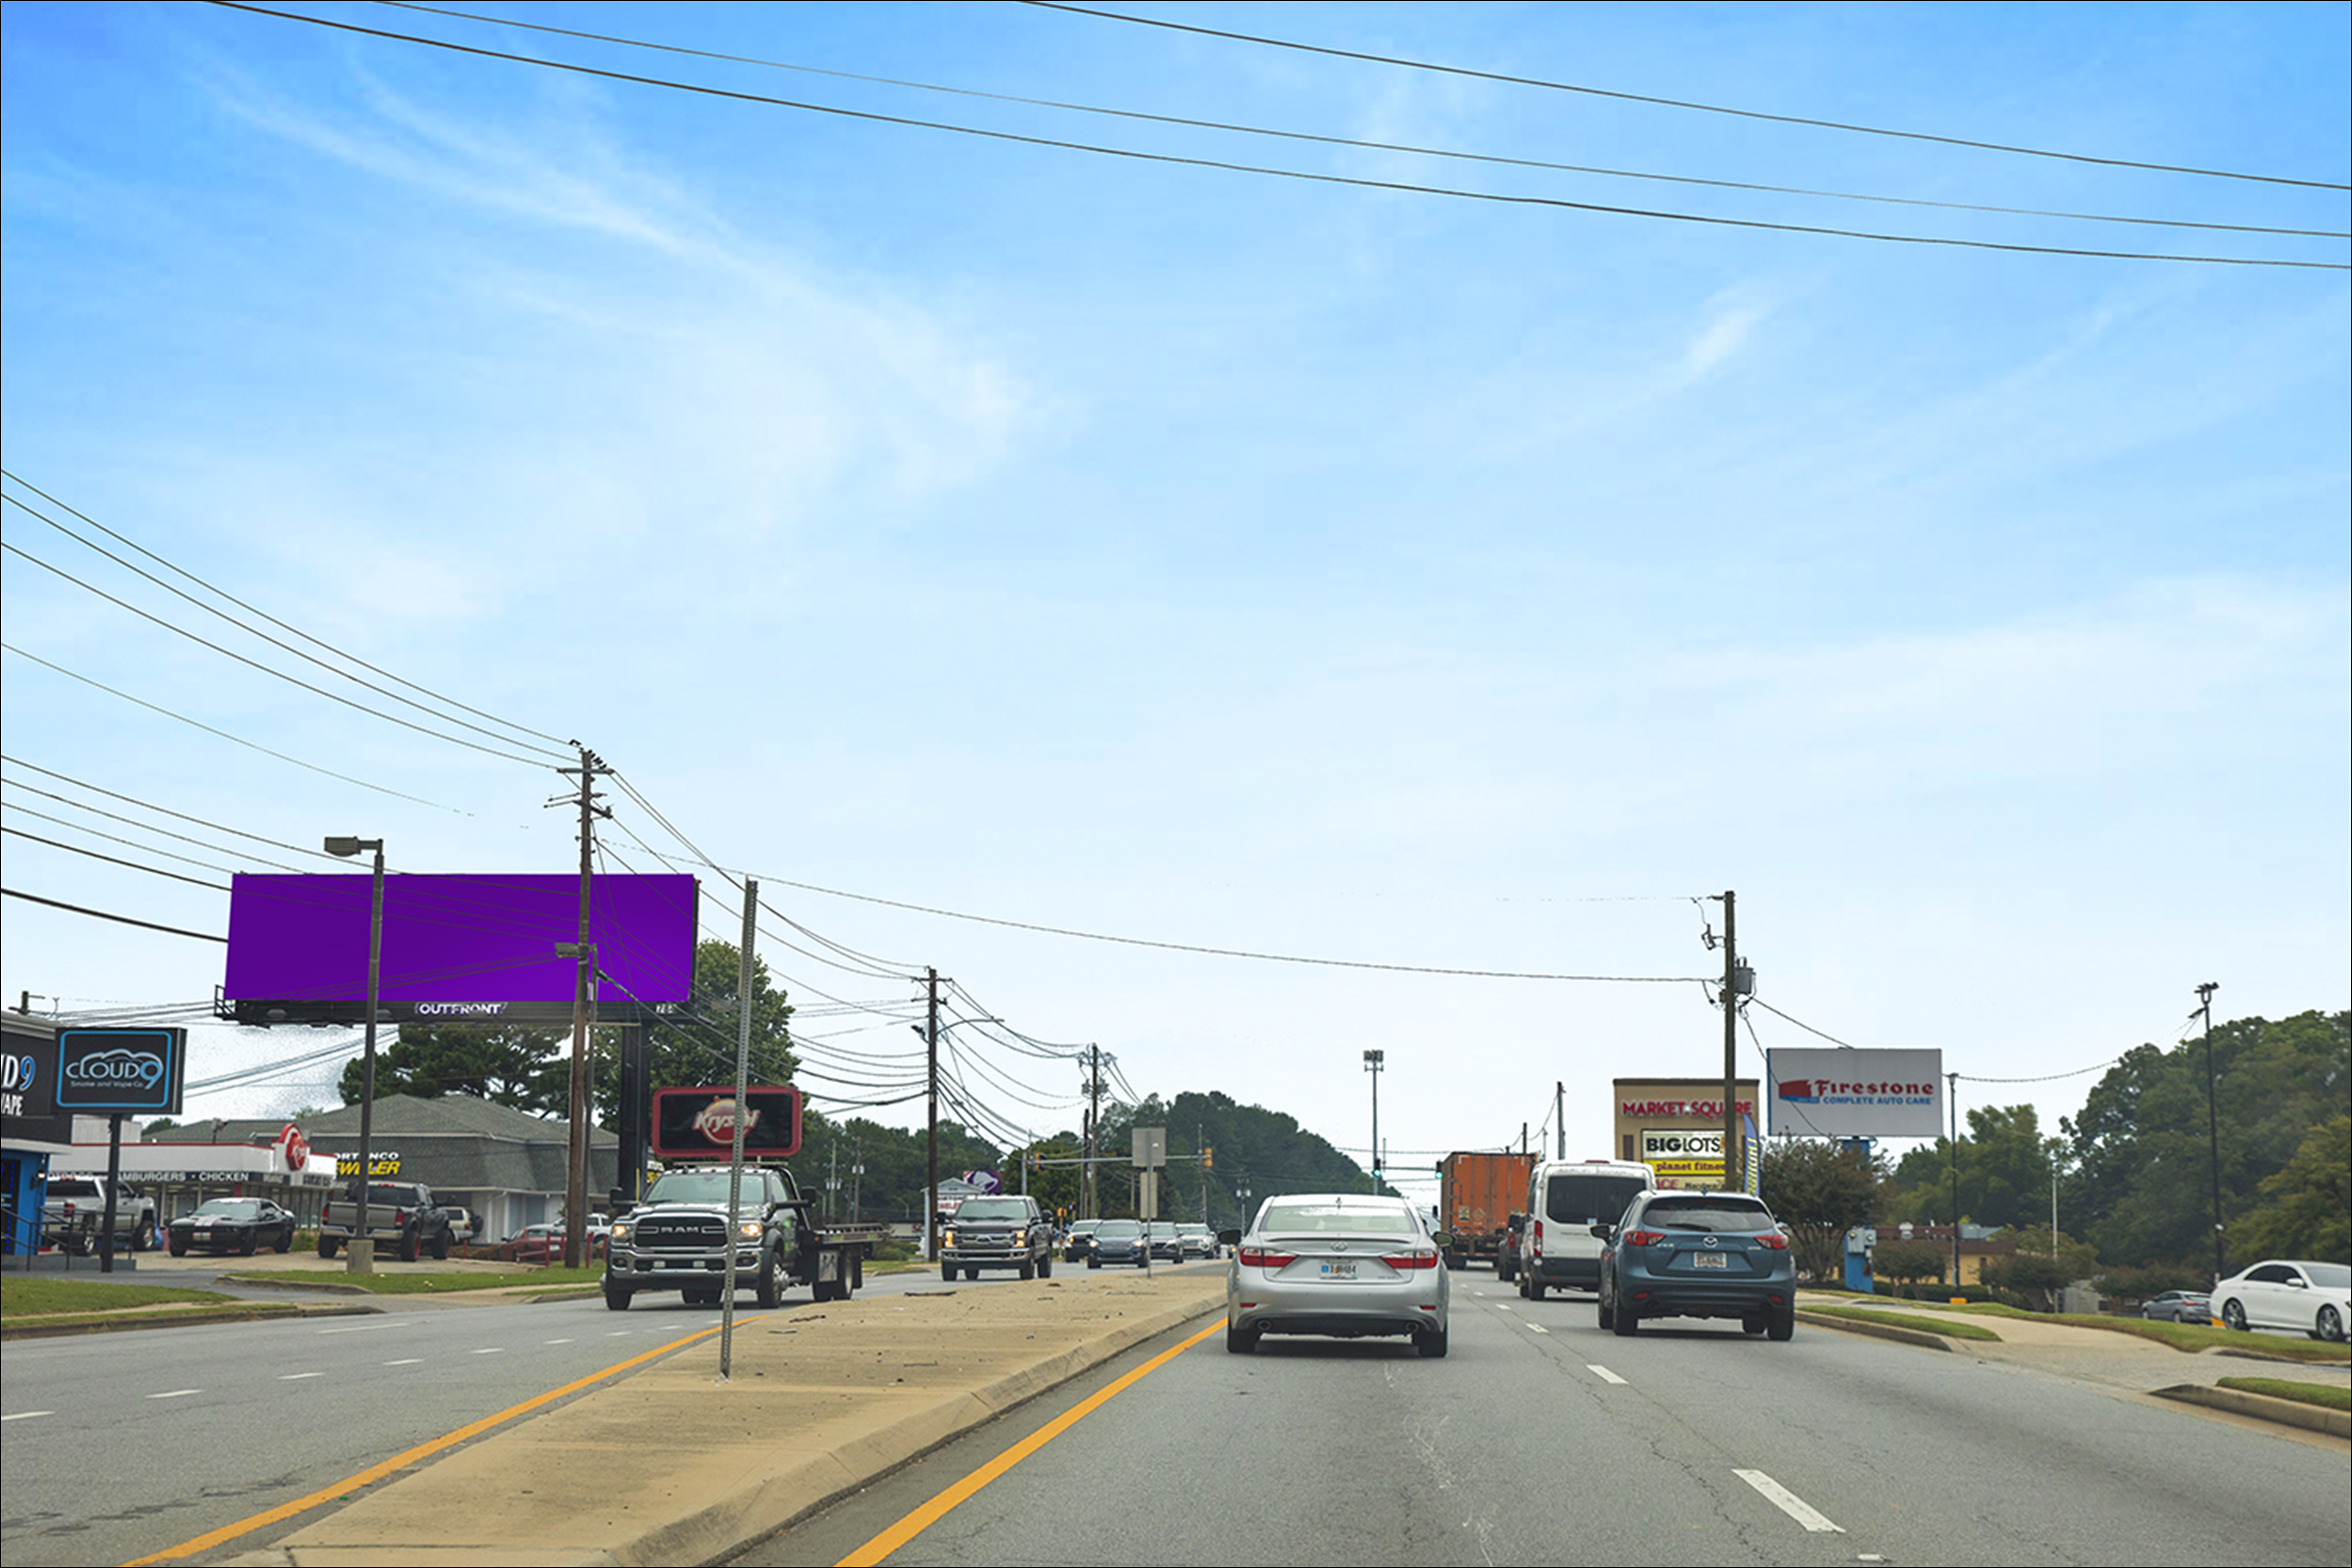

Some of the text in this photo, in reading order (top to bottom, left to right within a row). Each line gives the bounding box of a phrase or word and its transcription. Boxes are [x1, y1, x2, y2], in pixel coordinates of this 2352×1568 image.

[418, 1003, 502, 1014] OUTFRONT
[1815, 1079, 1935, 1097] Firestone
[1824, 1096, 1874, 1104] COMPLETE
[1877, 1096, 1903, 1104] AUTO
[1905, 1096, 1932, 1104] CARE
[1622, 1101, 1753, 1119] MARKET SQURE
[1656, 1161, 1691, 1173] planet
[199, 1171, 249, 1182] CHICKEN
